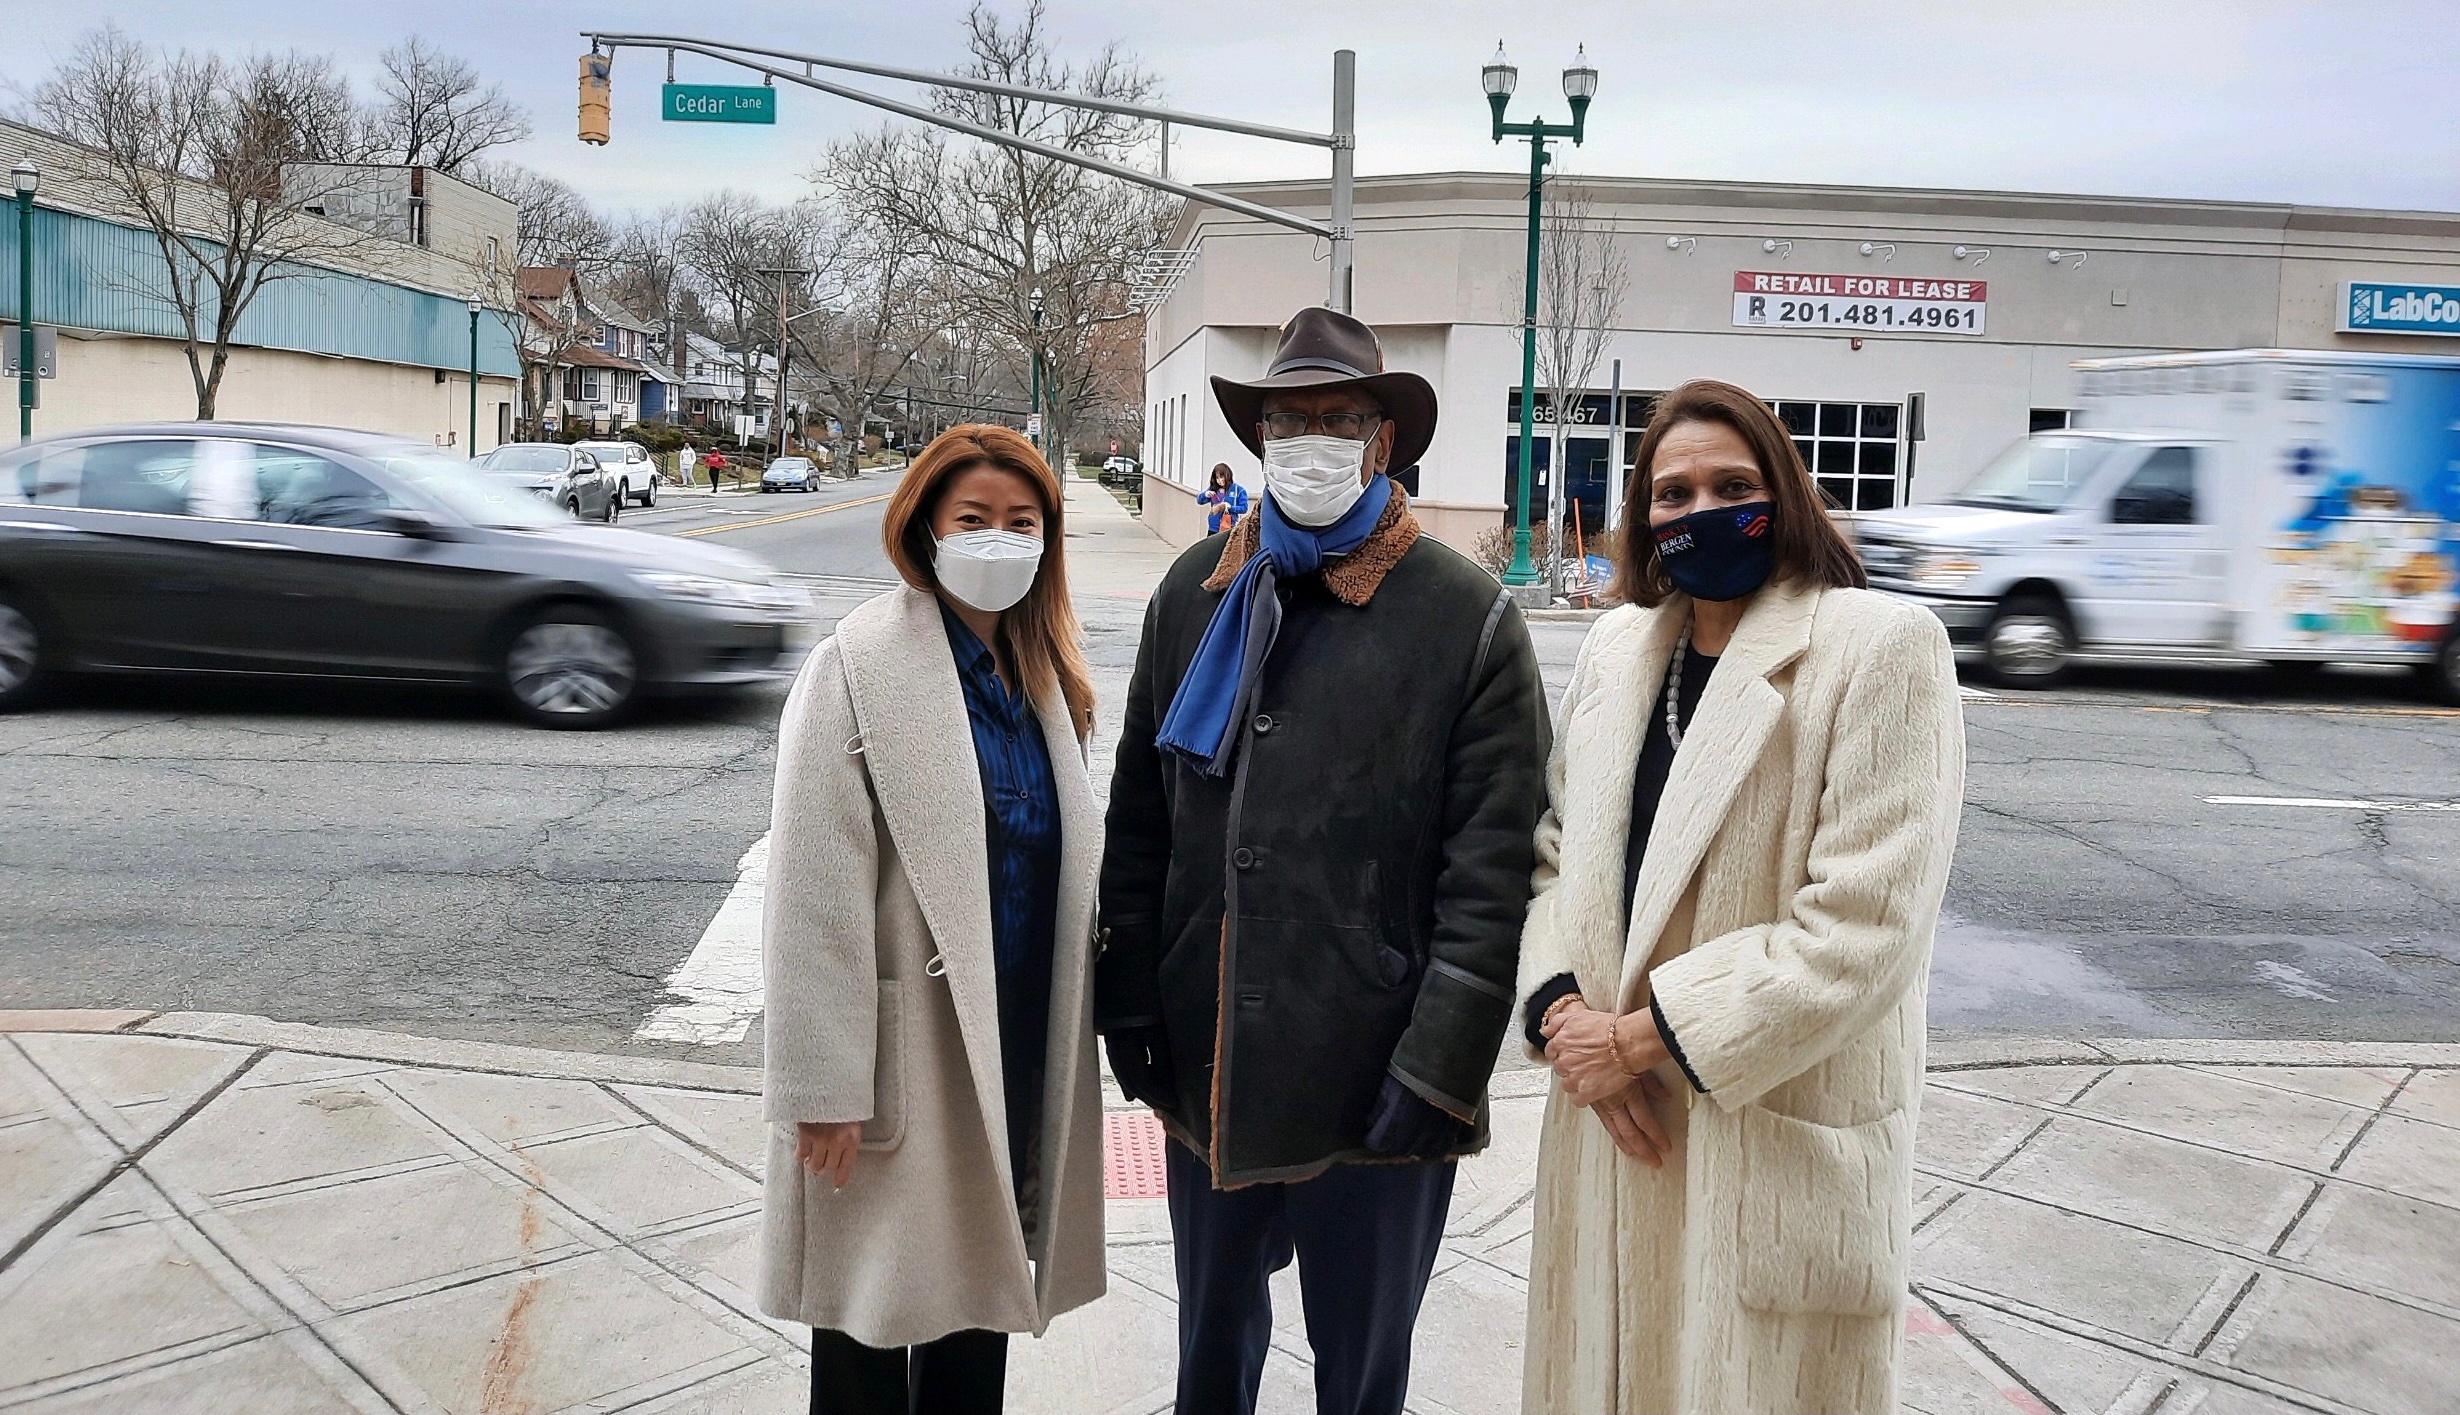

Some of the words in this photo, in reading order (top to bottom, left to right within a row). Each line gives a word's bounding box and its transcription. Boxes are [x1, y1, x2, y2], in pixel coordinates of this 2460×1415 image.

[675, 93, 726, 114] Cedar
[735, 95, 762, 109] Lane
[1754, 275, 1836, 294] RETAIL
[1844, 278, 1890, 297] FOR
[1898, 281, 1971, 299] LEASE
[1779, 301, 1975, 329] 201.481.4961
[2373, 290, 2460, 323] LabCo
[1660, 532, 1692, 551] BERGEN
